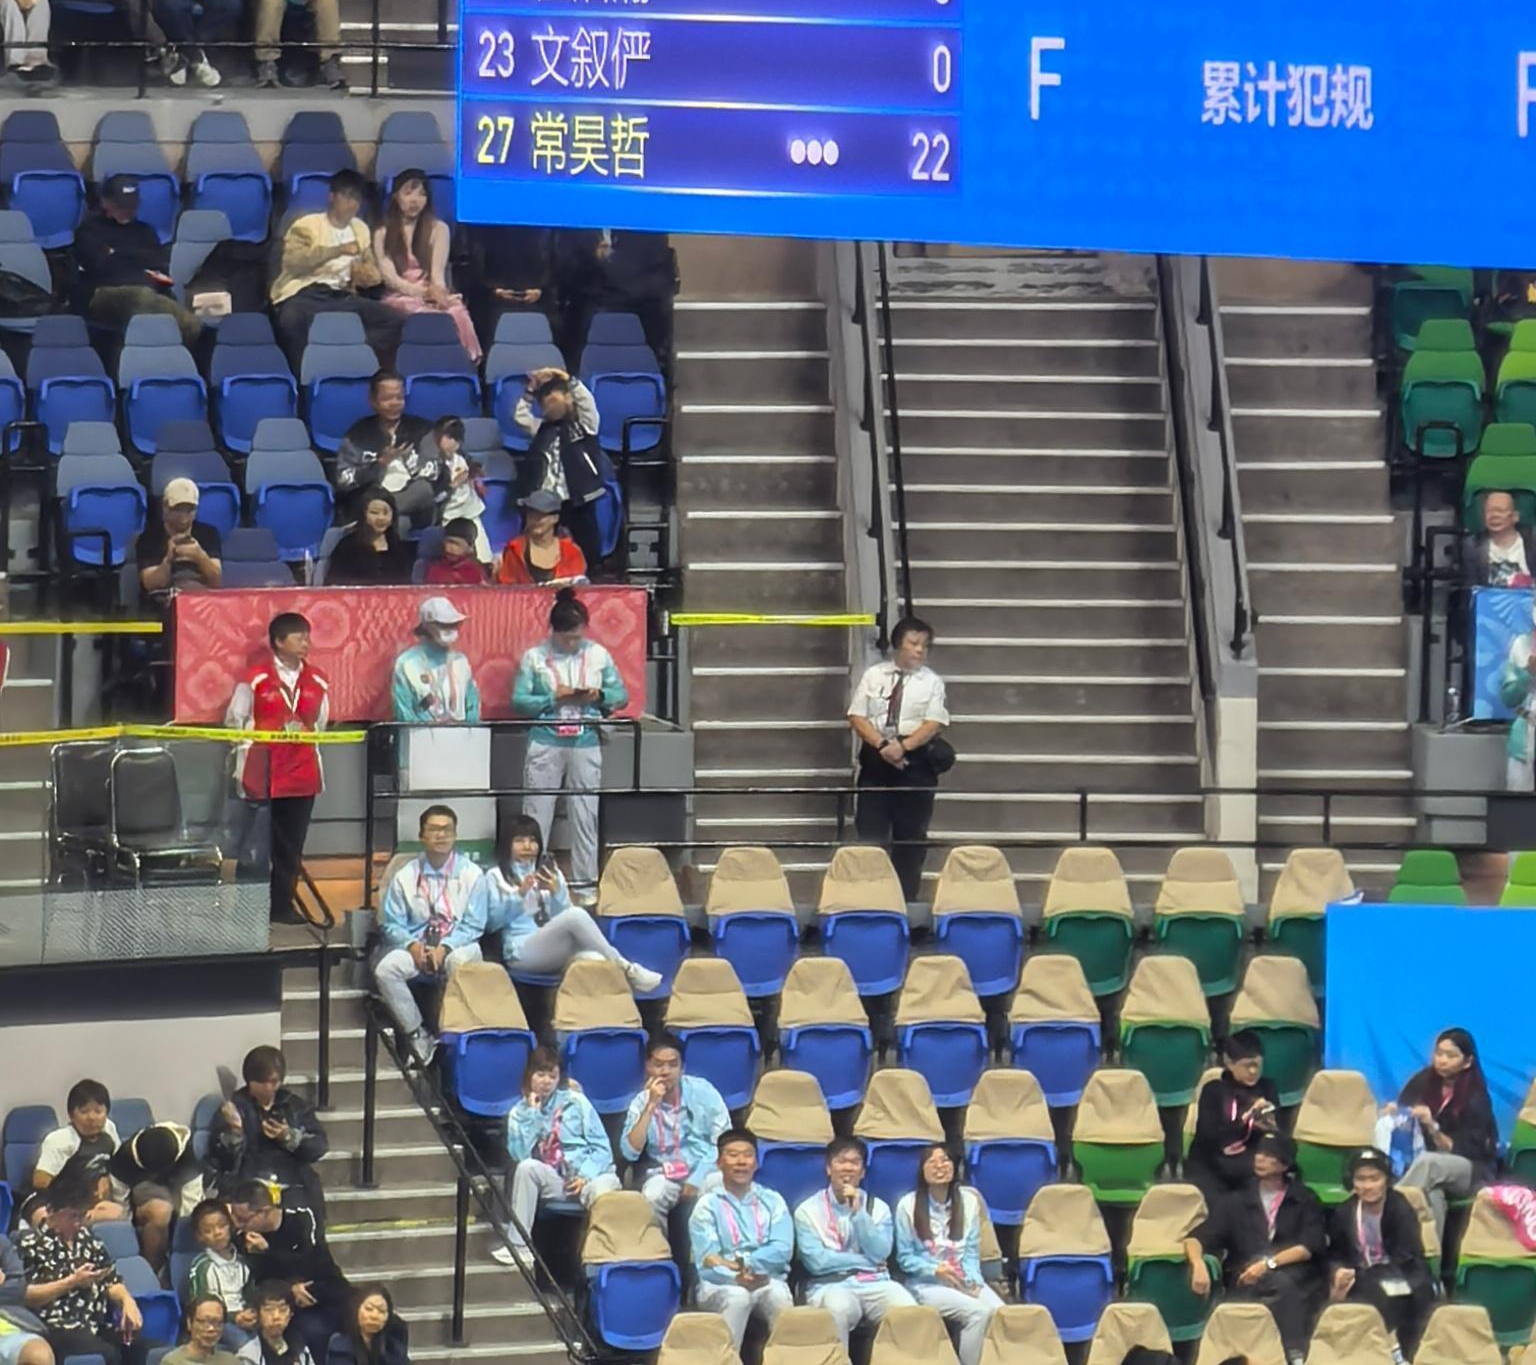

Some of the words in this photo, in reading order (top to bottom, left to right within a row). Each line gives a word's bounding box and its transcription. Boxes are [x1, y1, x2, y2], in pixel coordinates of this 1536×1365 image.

[479, 30, 514, 77] 23
[532, 25, 650, 89] 文叙俨
[933, 45, 950, 92] 0
[1030, 37, 1065, 120] F
[1202, 61, 1373, 129] 累计犯规
[478, 115, 514, 163] 27
[531, 111, 649, 177] 常昊哲
[912, 132, 949, 180] 22
